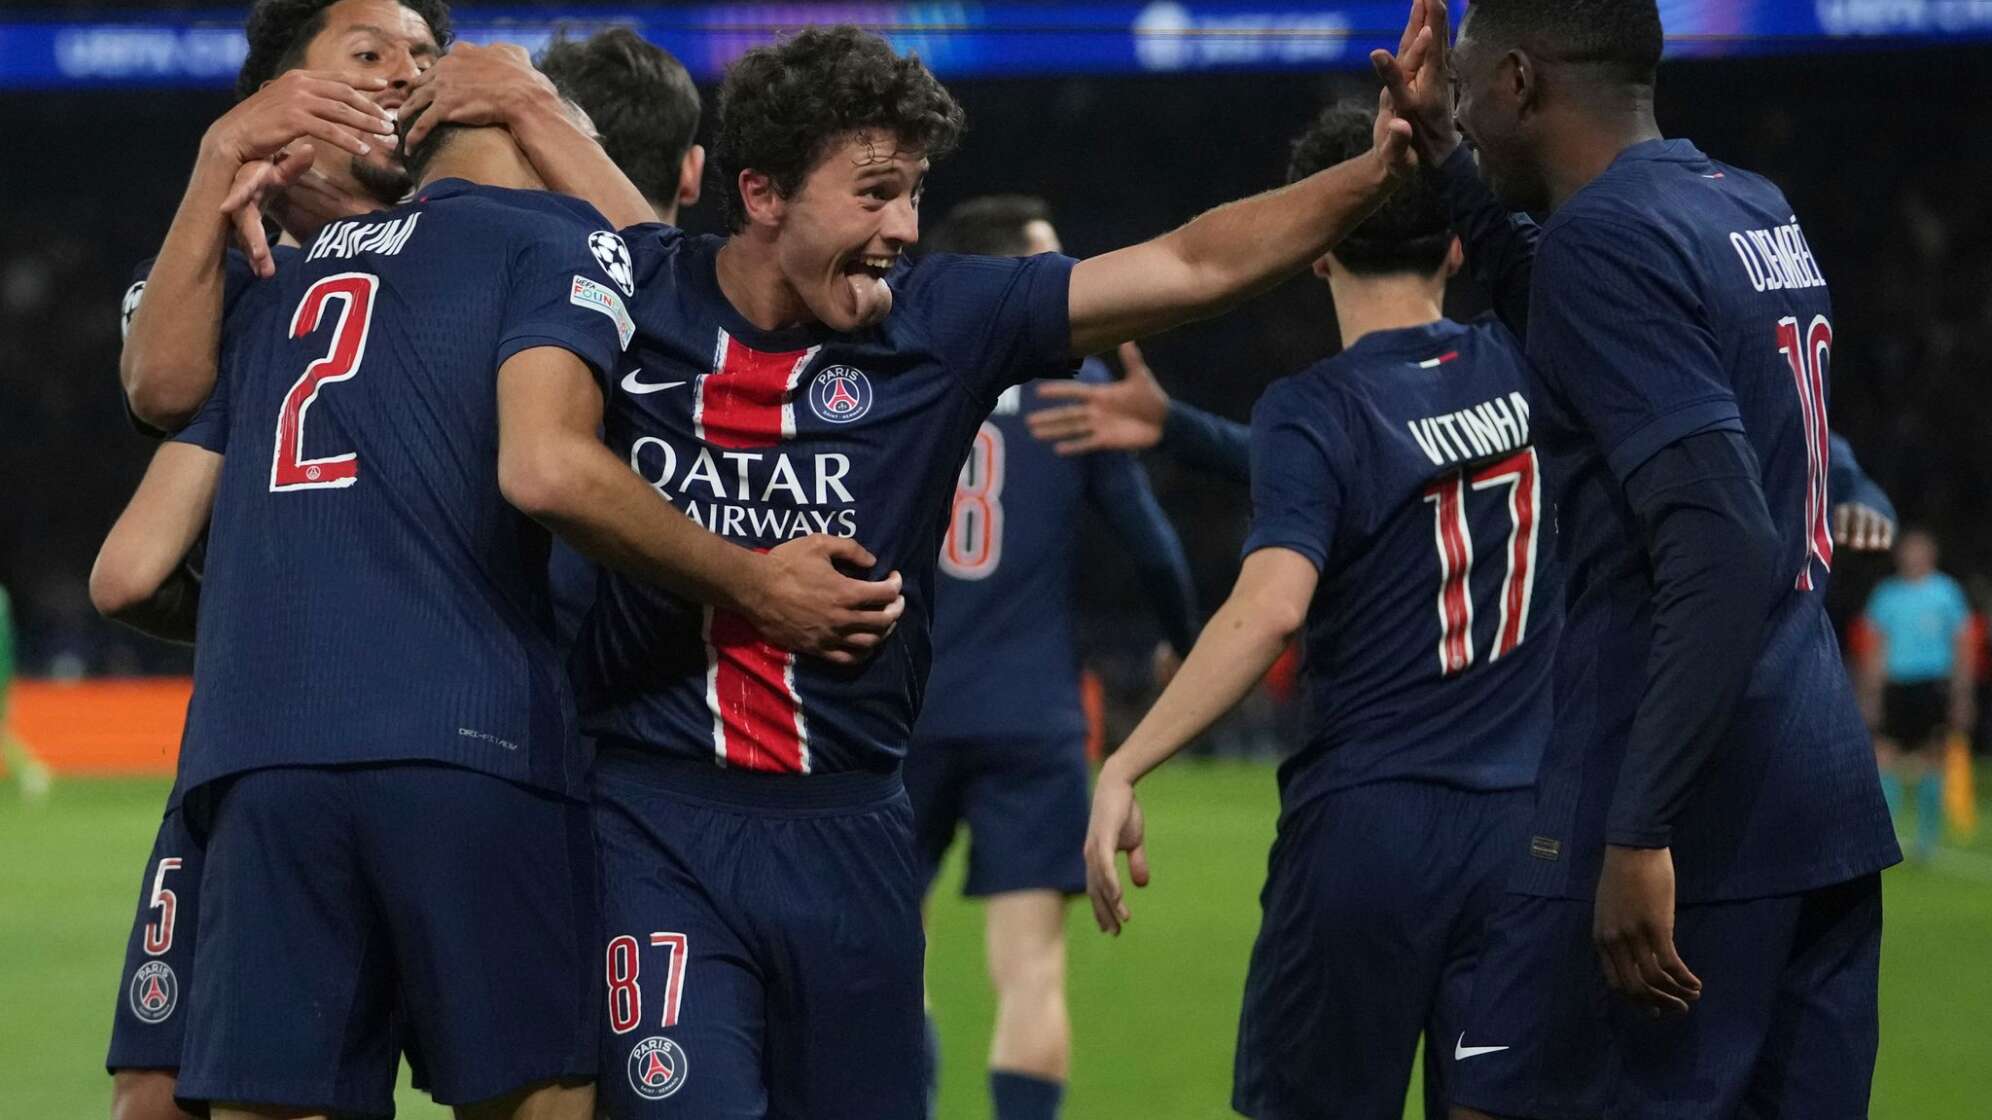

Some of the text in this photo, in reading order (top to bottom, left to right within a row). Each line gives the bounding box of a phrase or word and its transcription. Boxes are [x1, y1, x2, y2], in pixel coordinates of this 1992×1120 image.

[304, 211, 422, 263] HAKIMI
[269, 272, 379, 492] 2
[818, 367, 859, 385] PARIS
[1408, 391, 1530, 466] VITINHA
[1776, 314, 1833, 592] 10
[631, 436, 855, 505] QATAR
[938, 420, 1006, 580] 8
[684, 500, 857, 540] AIRWAYS
[1423, 446, 1541, 677] 17
[144, 857, 183, 956] 5
[138, 963, 169, 982] PARIS
[606, 931, 688, 1035] 87
[633, 1040, 673, 1060] PARIS
